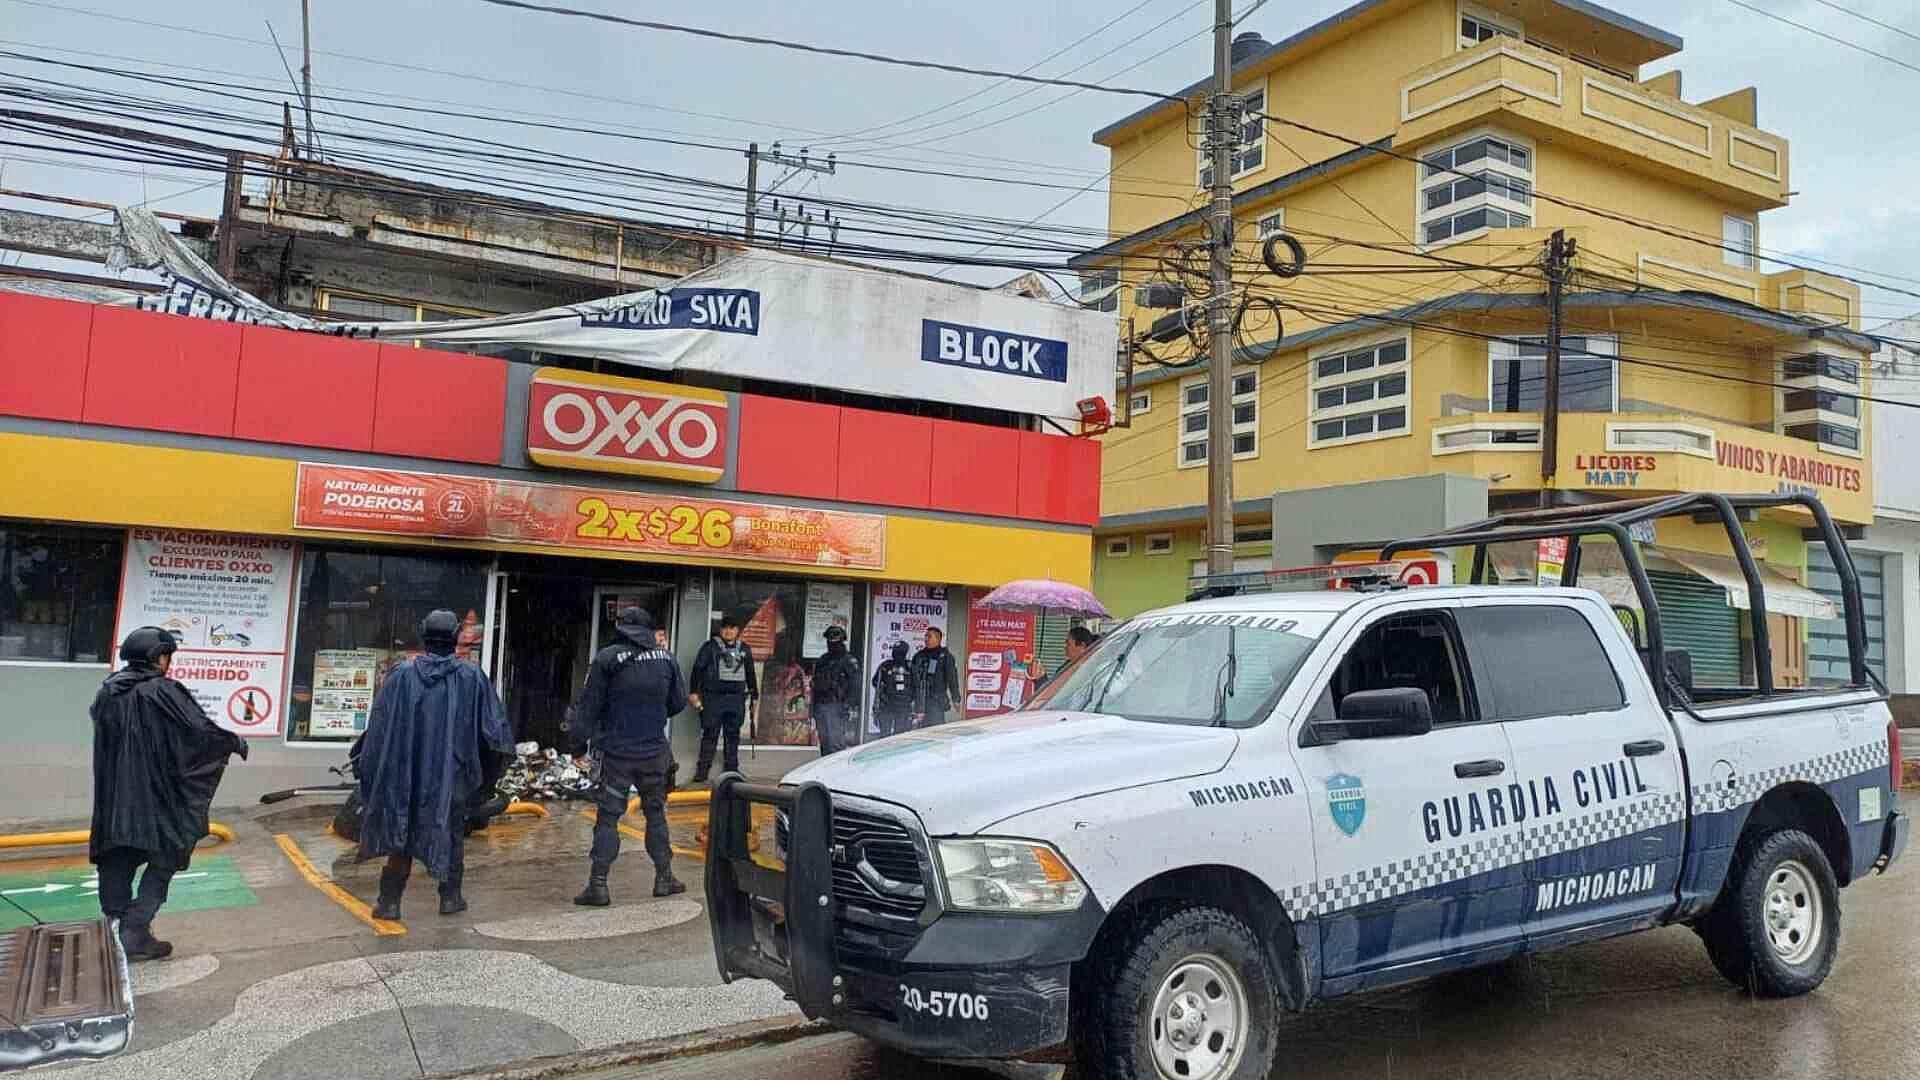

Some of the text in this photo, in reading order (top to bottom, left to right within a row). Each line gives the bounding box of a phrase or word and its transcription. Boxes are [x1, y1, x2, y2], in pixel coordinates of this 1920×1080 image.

[690, 294, 753, 329] SIKA
[939, 327, 1043, 374] BLOCK
[543, 393, 717, 459] OXXO
[1575, 455, 1656, 471] LICORES
[1715, 439, 1765, 474] VINOS
[1778, 455, 1861, 493] ABARROTES
[1585, 471, 1641, 486] MARY
[324, 479, 426, 498] NATURALMENTE
[324, 492, 425, 513] PODEROSA
[133, 529, 291, 550] ESTACIONAMIENTO
[163, 545, 262, 561] EXCLUSIVO PARA
[149, 555, 273, 574] CLIENTES OXXO
[149, 570, 188, 582] Tiempo
[235, 575, 249, 583] 20
[883, 602, 942, 616] TU EFECTIVO
[891, 622, 900, 632] EN
[176, 656, 268, 670] ESTRICTAMENTE
[166, 667, 249, 682] OHIBIDO
[1188, 775, 1295, 808] MICHOACÁN
[1422, 756, 1648, 843] GUARDIA CIVIL
[900, 983, 989, 1021] 20-5706
